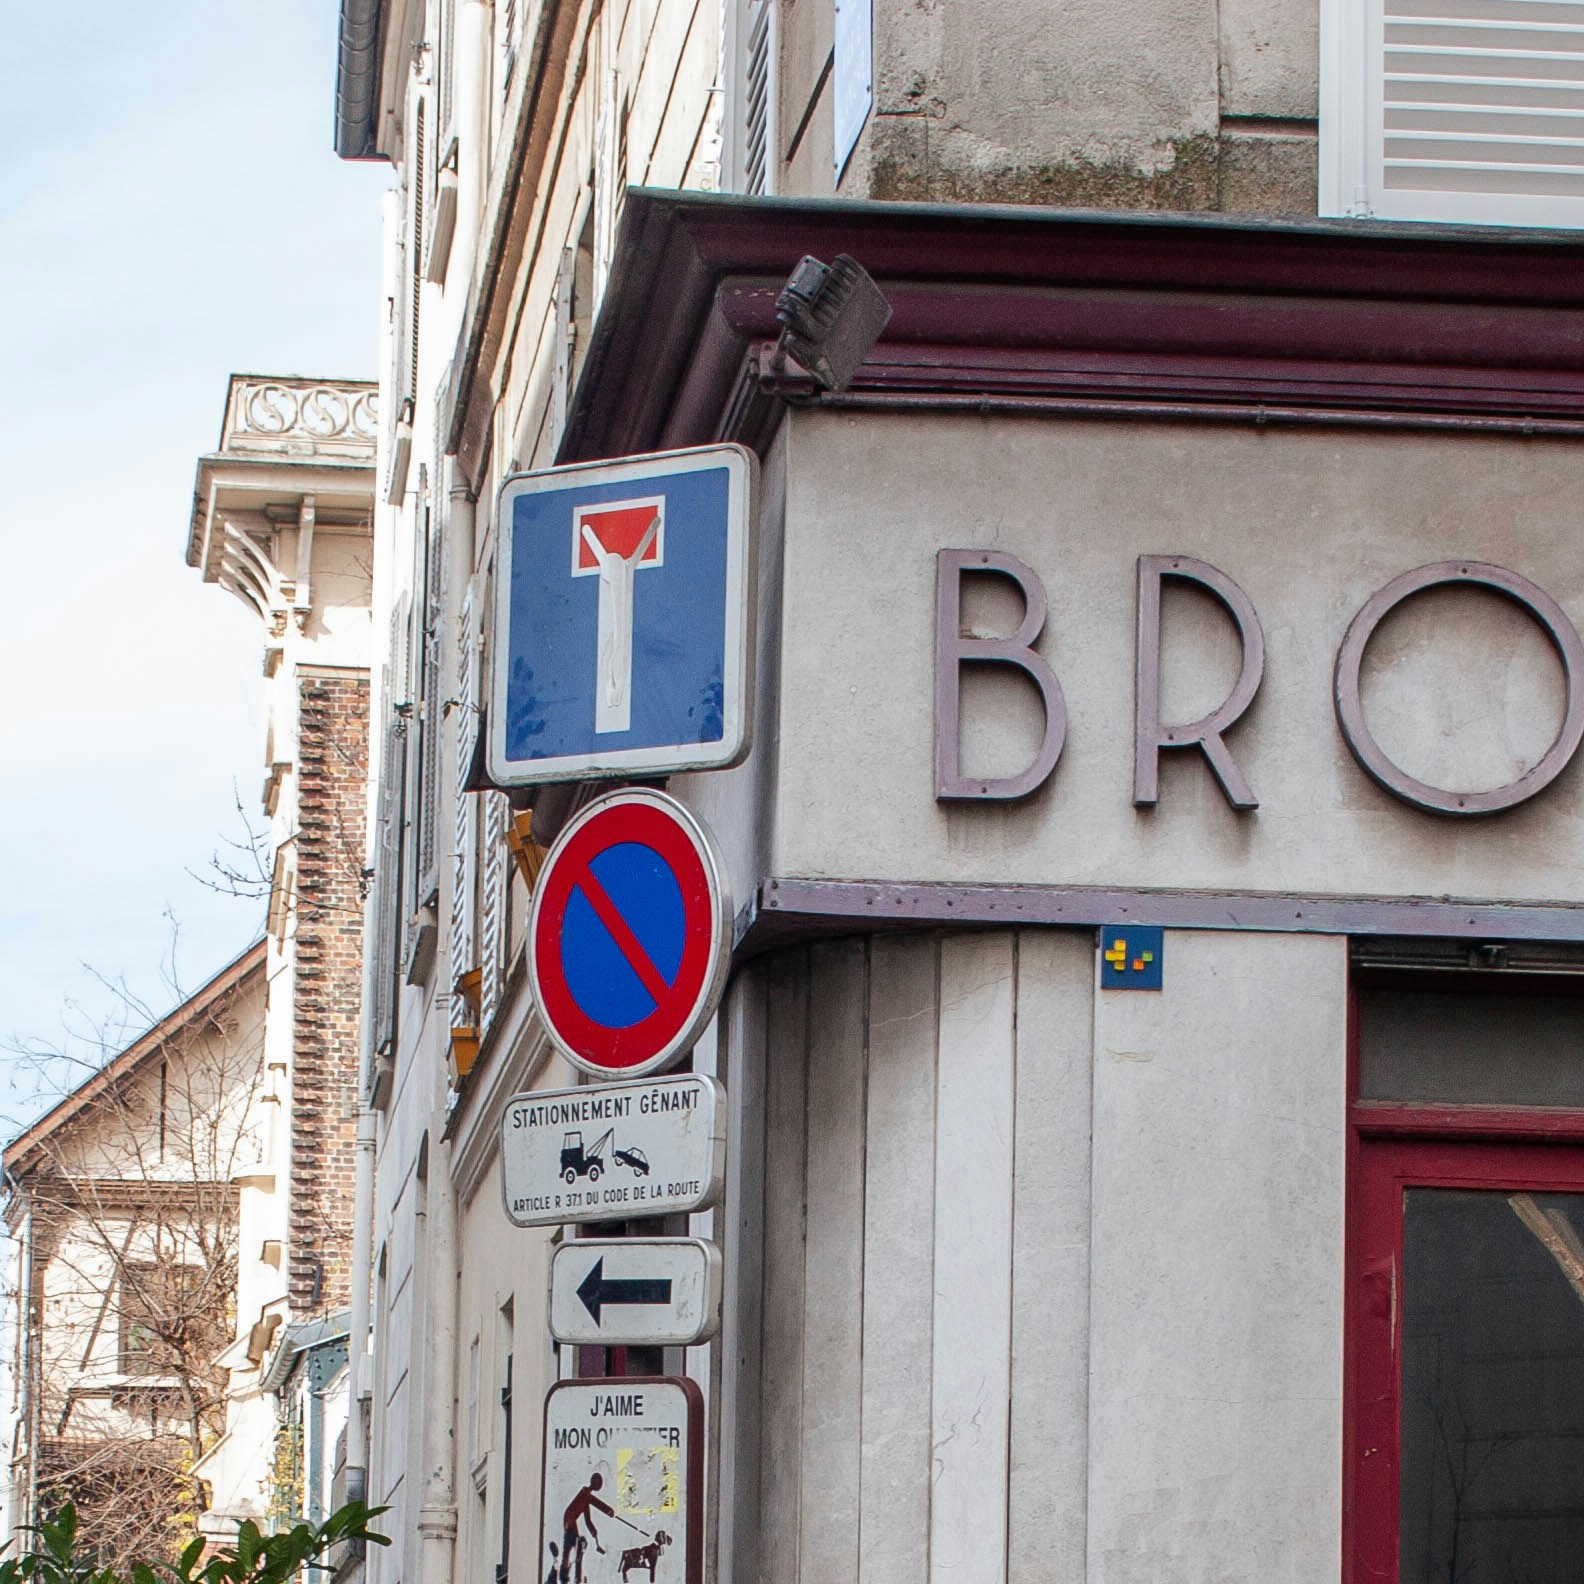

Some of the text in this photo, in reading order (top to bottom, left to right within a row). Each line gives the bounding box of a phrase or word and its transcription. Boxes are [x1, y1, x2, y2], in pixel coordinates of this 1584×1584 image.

[513, 1089, 700, 1129] STATIONNEMENT GÊNANT
[513, 1195, 551, 1213] ARTICLE
[555, 1195, 562, 1209] R
[586, 1190, 599, 1206] DU
[604, 1187, 629, 1204] CODE
[633, 1185, 646, 1201] DE
[650, 1184, 663, 1199] LA
[667, 1180, 700, 1197] ROUTE
[590, 1394, 644, 1417] J'AIME
[554, 1427, 591, 1449] MON
